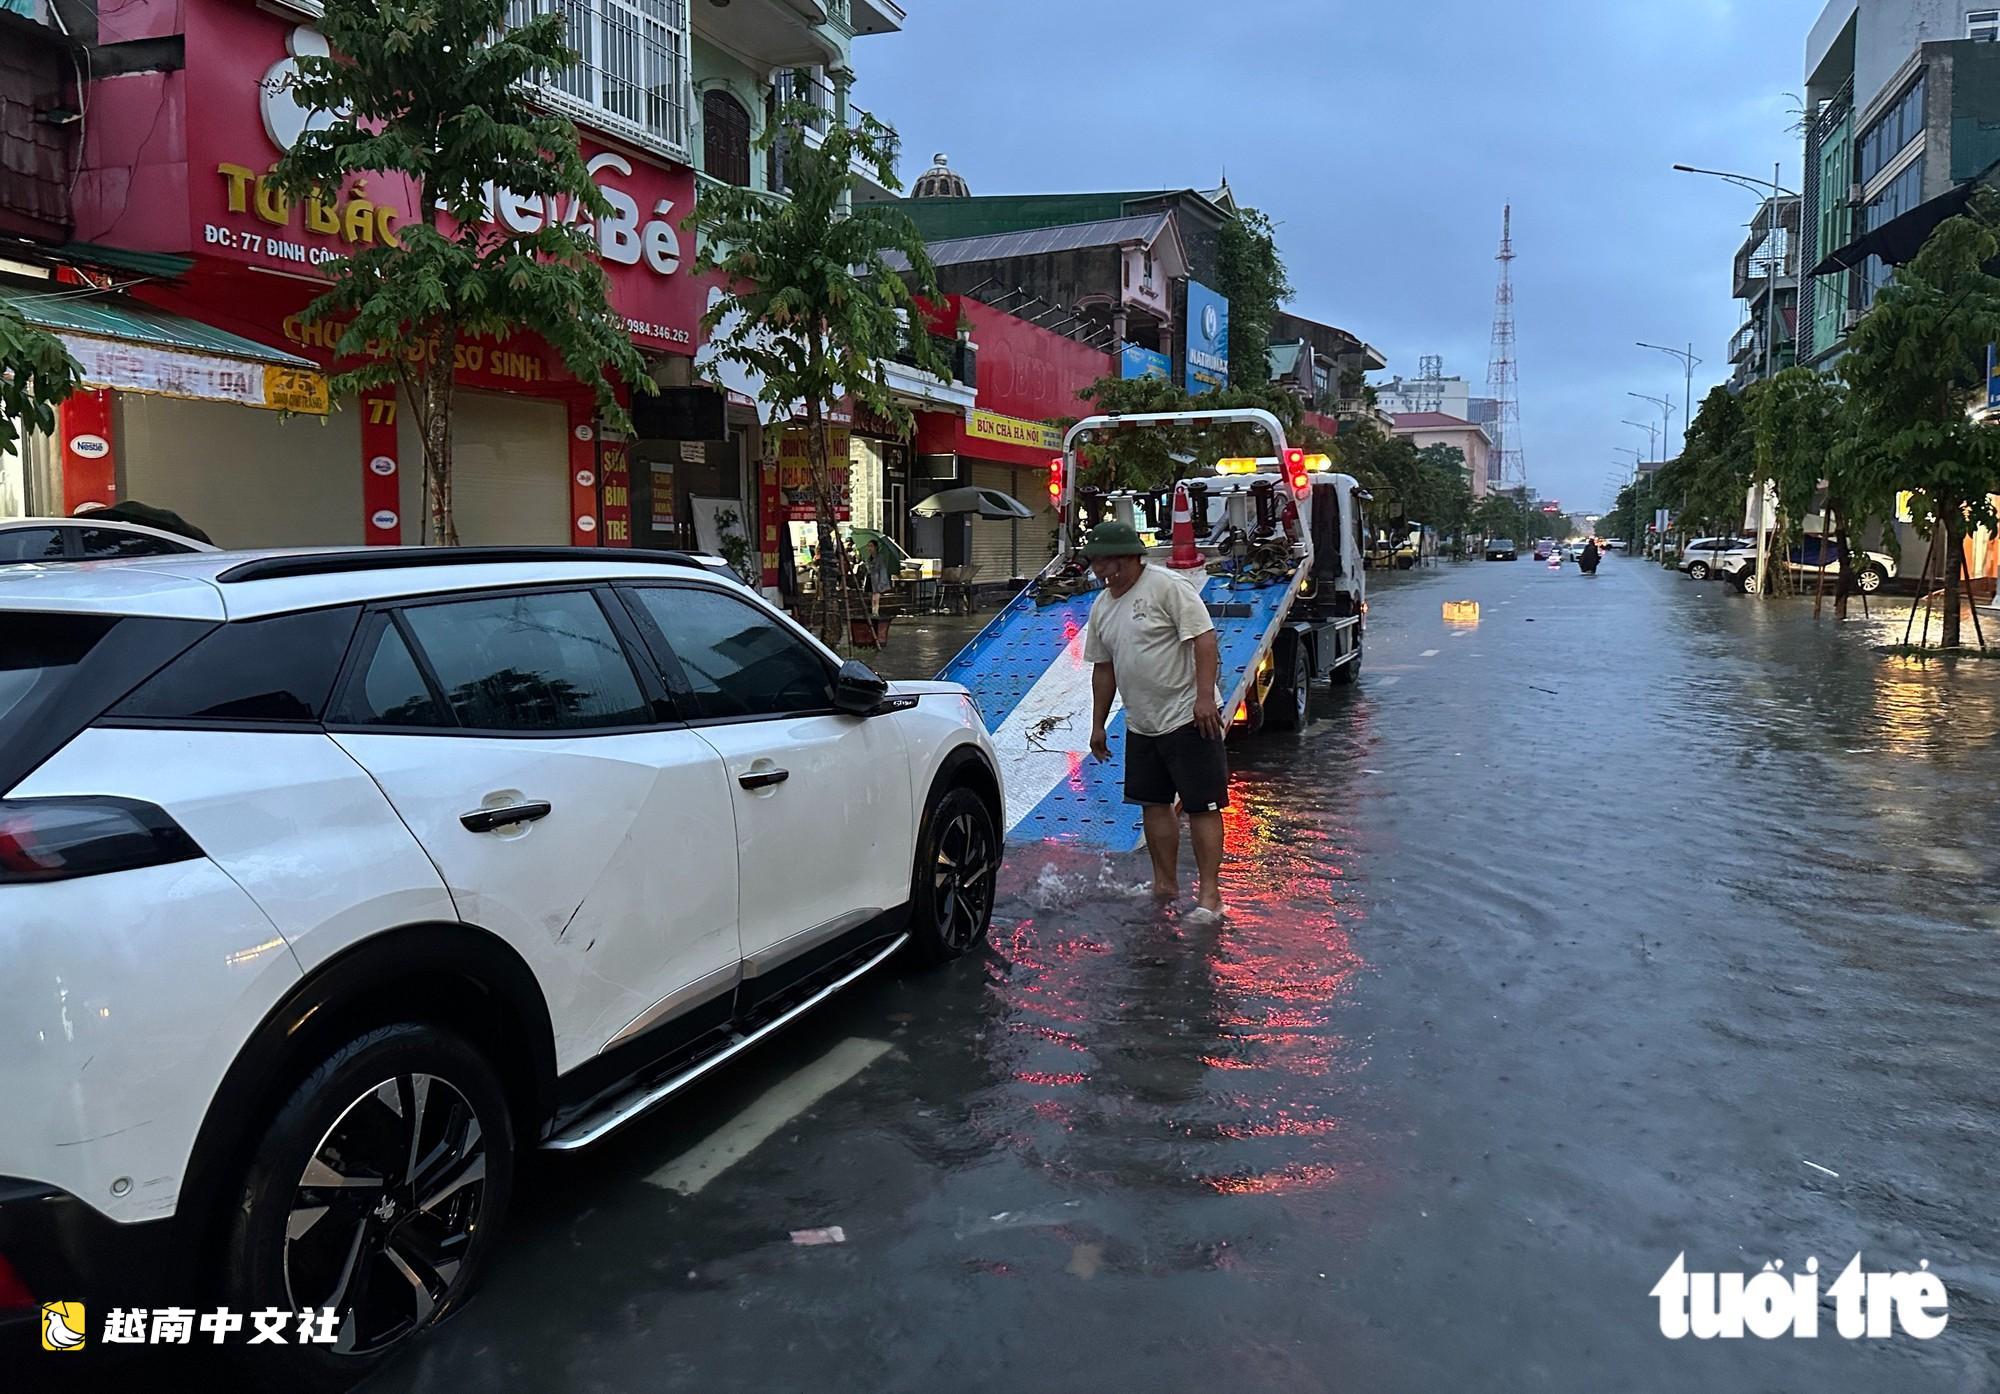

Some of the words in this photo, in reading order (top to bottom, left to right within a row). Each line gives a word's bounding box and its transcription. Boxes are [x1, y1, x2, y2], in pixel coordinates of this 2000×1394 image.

[204, 223, 238, 248] ĐC:
[240, 231, 263, 253] 77
[266, 238, 306, 264] ĐINH
[600, 184, 681, 276] Bé
[490, 350, 542, 382] SINH
[367, 399, 397, 425] 77
[604, 479, 628, 507] BỈM
[606, 513, 628, 540] TRẺ
